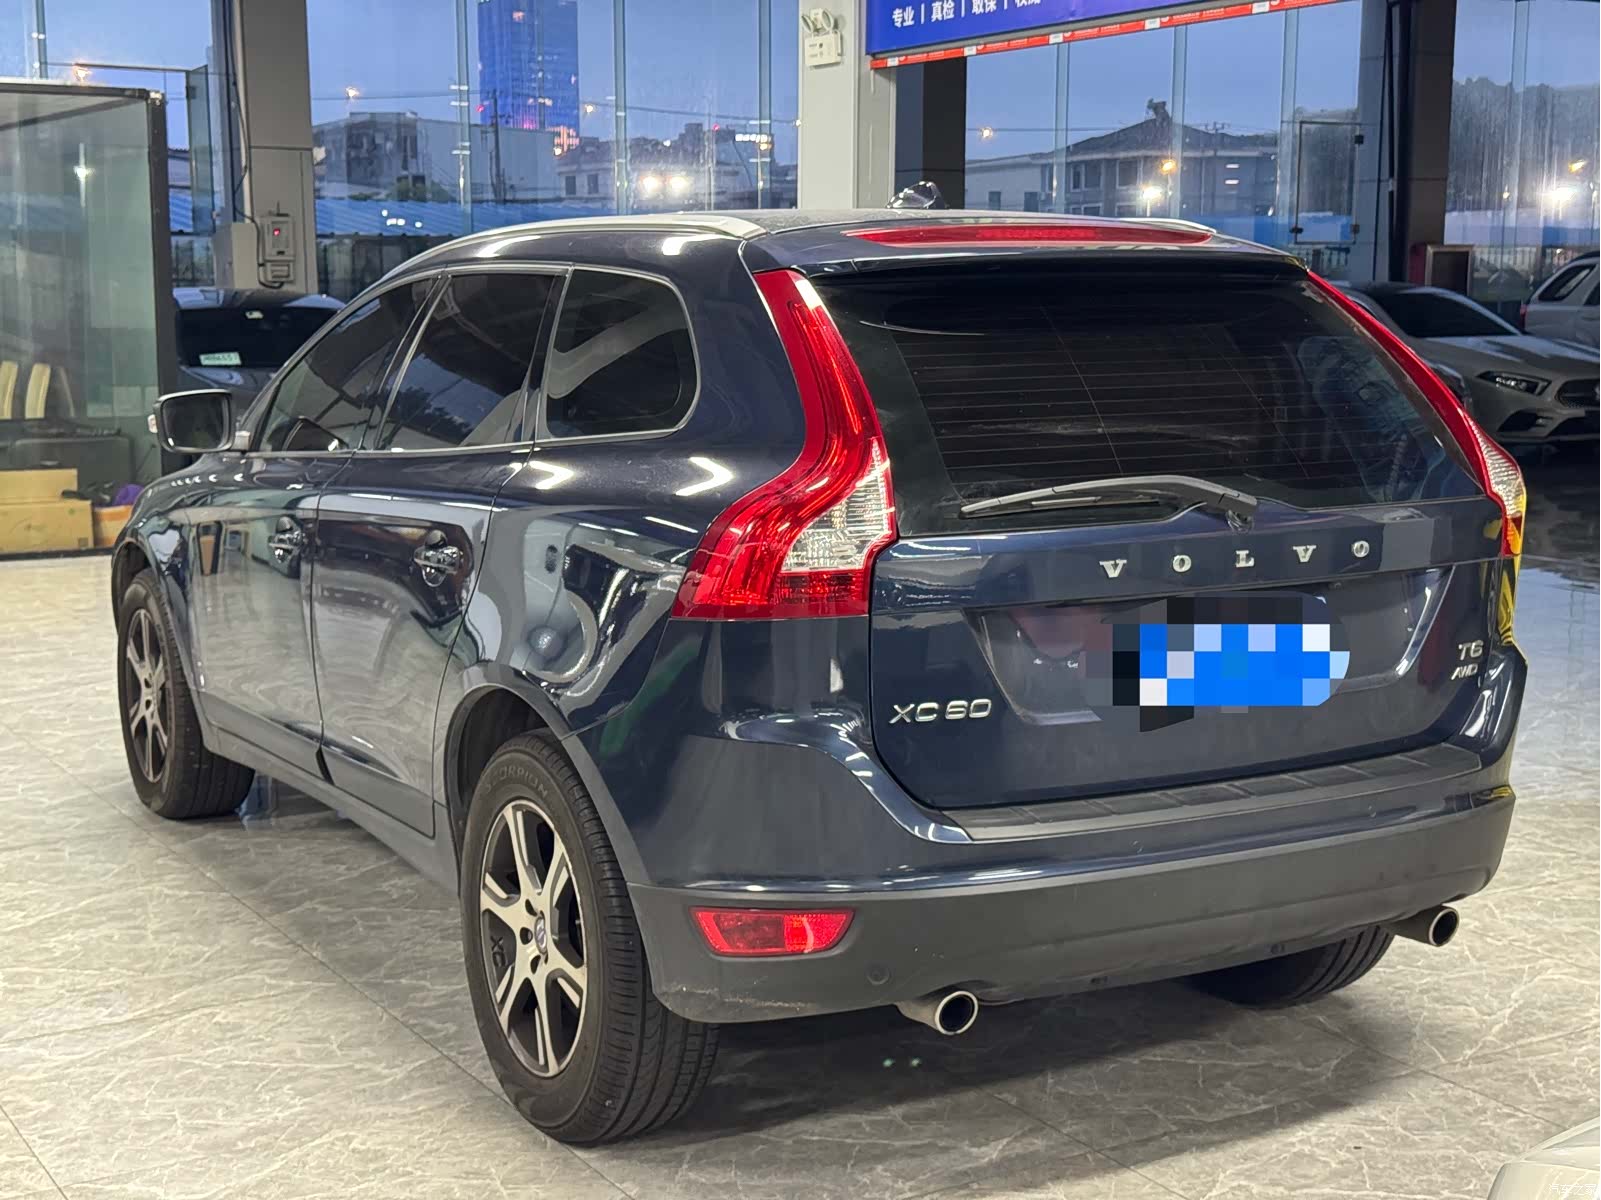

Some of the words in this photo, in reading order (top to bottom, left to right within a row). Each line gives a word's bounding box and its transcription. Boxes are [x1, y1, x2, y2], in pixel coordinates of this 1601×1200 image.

[892, 6, 915, 28] 专业
[931, 0, 955, 22] 真检
[1099, 540, 1370, 578] VOLVO
[1458, 640, 1484, 660] T6
[1451, 663, 1478, 680] AWD
